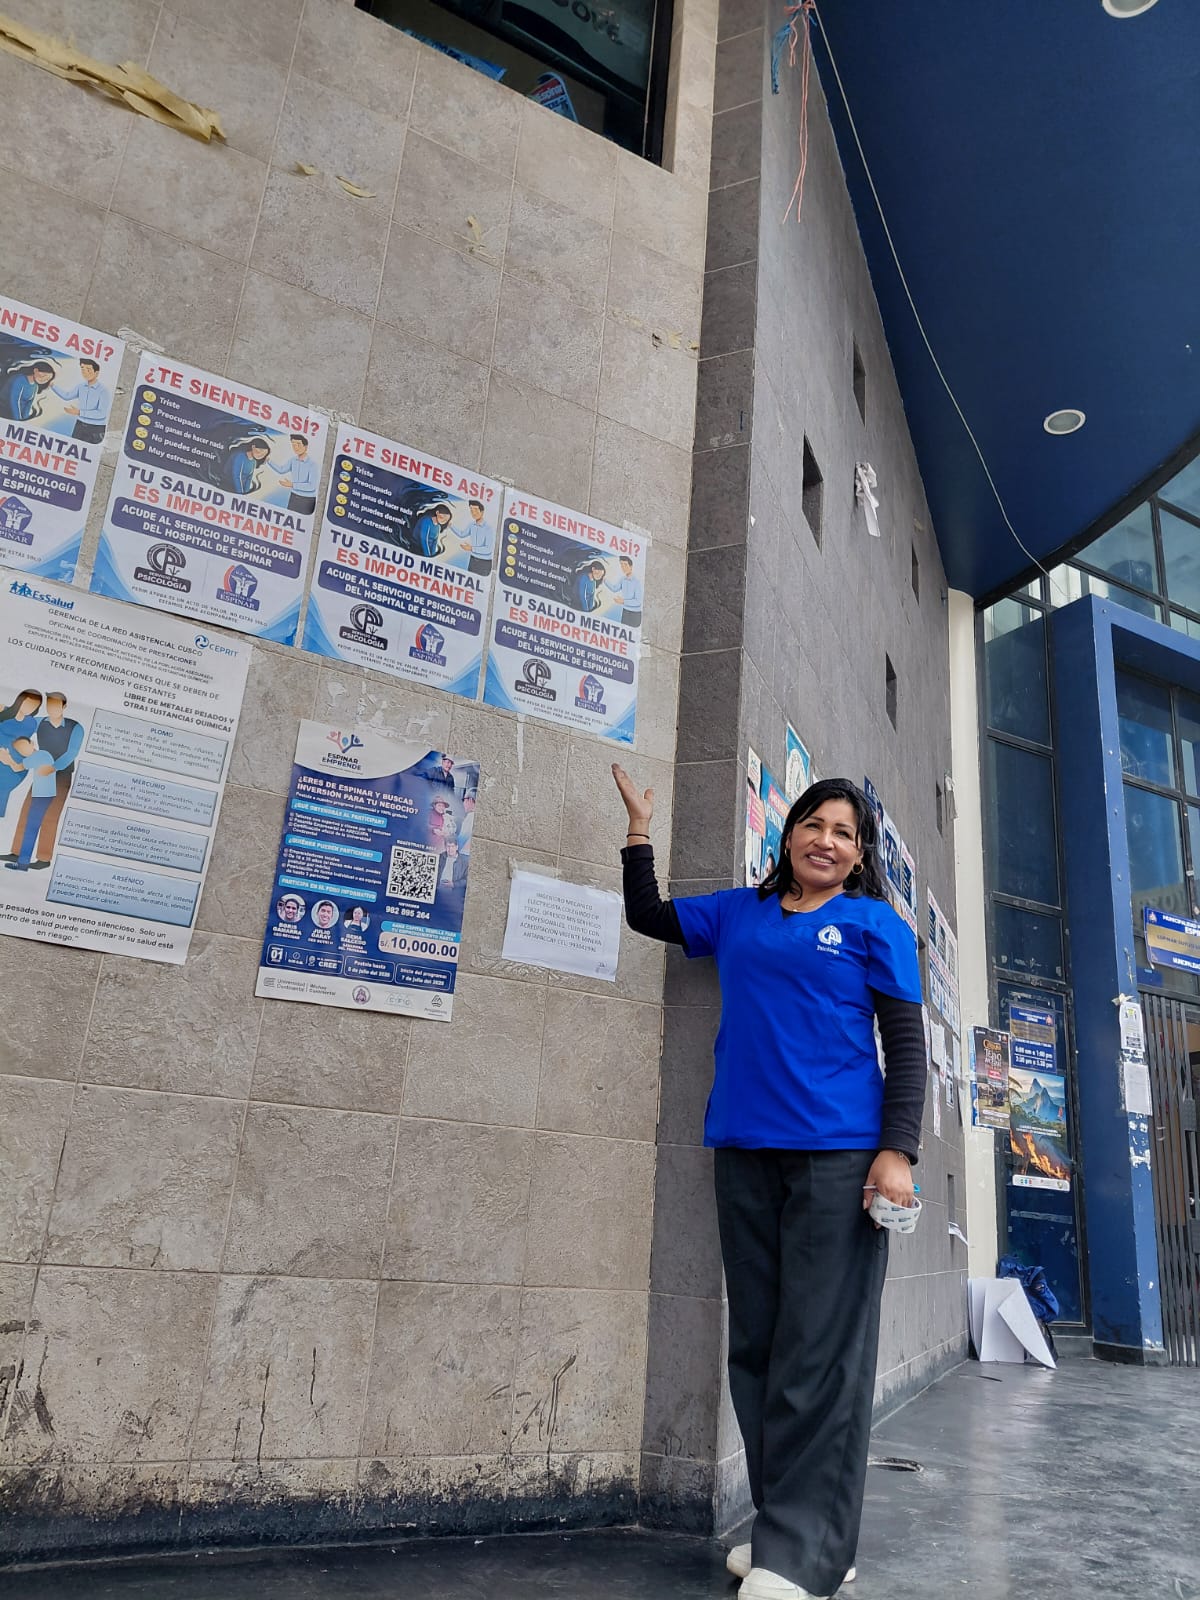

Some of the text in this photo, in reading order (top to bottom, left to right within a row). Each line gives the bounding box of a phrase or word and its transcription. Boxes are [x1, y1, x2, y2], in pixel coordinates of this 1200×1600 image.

[0, 308, 114, 362] NTES ASÍ?
[144, 366, 320, 436] ¿TE SIENTES ASÍ?
[160, 396, 180, 410] Triste
[157, 408, 201, 429] Preocupado
[6, 424, 92, 464] MENTAL
[152, 434, 216, 460] No puedes dormir
[154, 421, 225, 450] Sin ganas de hacer nada
[148, 446, 201, 469] Muy estresado
[342, 438, 494, 502] ¿TE SIENTES ASÍ?
[2, 478, 50, 499] ESPINAR
[12, 467, 77, 496] PSICOLOGÍA
[127, 464, 306, 533] TU SALUD MENTAL
[133, 484, 295, 546] ES IMPORTANTE
[509, 501, 641, 558] ¿TE SIENTES ASÍ?
[121, 503, 295, 564] ACUDE AL SERVICIO DE PSICOLOGÍA
[143, 522, 272, 567] DEL HOSPITAL DE ESPINAR
[330, 530, 484, 593] TU SALUD MENTAL
[336, 548, 474, 605] ES IMPORTANTE
[137, 572, 188, 592] PSICOLOGÍA
[326, 568, 475, 622] ACUDE AL SERVICIO DE PSICOLOGÍA
[32, 590, 74, 610] EsSalud
[344, 583, 456, 626] DEL HOSPITAL DE ESPINAR
[49, 608, 203, 656] GERENCIA DE LA RED ASISTENCIAL CUSCO
[503, 590, 636, 643] TU SALUD MENTAL
[509, 607, 628, 656] ES IMPORTANTE
[48, 620, 76, 632] OFICINA
[77, 627, 86, 635] DE
[148, 648, 197, 666] PRESTACIONES
[209, 644, 239, 657] CEPRIT
[342, 631, 386, 649] PSICOLOGÍA
[501, 625, 629, 671] ACUDE AL SERVICIO DE PSICOLOGÍA
[8, 637, 23, 647] LOS
[25, 641, 67, 659] CUIDADOS
[76, 656, 153, 683] RECOMENDACIONES
[155, 678, 171, 687] QUE
[183, 685, 208, 697] DEBEN
[209, 692, 220, 700] DE
[517, 640, 614, 676] DEL HOSPITAL DE ESPINAR
[50, 660, 77, 673] TENER
[77, 667, 98, 678] PARA
[100, 674, 125, 686] NIÑOS
[134, 681, 176, 699] GESTANTES
[123, 700, 148, 712] OTRAS
[150, 707, 194, 723] SUSTANCIAS
[124, 692, 146, 702] LIBRE
[147, 698, 158, 706] DE
[160, 701, 193, 714] METALES
[194, 710, 227, 723] PESADOS
[150, 727, 174, 738] PLOMO
[322, 757, 362, 771] EMPRENDE
[327, 752, 359, 764] ESPINAR
[131, 777, 166, 790] MERCURIO
[297, 783, 341, 799] INVERSIÓN
[343, 791, 365, 801] PARA
[366, 796, 378, 806] TU
[379, 799, 419, 815] NEGOCIO?
[298, 775, 413, 805] ¿ERES DE ESPINAR Y BUSCAS
[126, 824, 151, 835] CADMIO
[112, 874, 145, 886] ARSÉNICO
[6, 905, 39, 916] pesados
[41, 910, 55, 918] son
[56, 912, 67, 920] un
[68, 915, 96, 926] veneno
[98, 920, 136, 933] silencioso.
[139, 928, 155, 936] Solo
[19, 915, 30, 924] de
[32, 918, 52, 928] salud
[54, 923, 78, 933] puede
[80, 927, 117, 939] confirmar
[136, 937, 156, 947] salud
[158, 941, 174, 950] está
[271, 950, 283, 960] 01
[391, 937, 457, 958] 10,000.00
